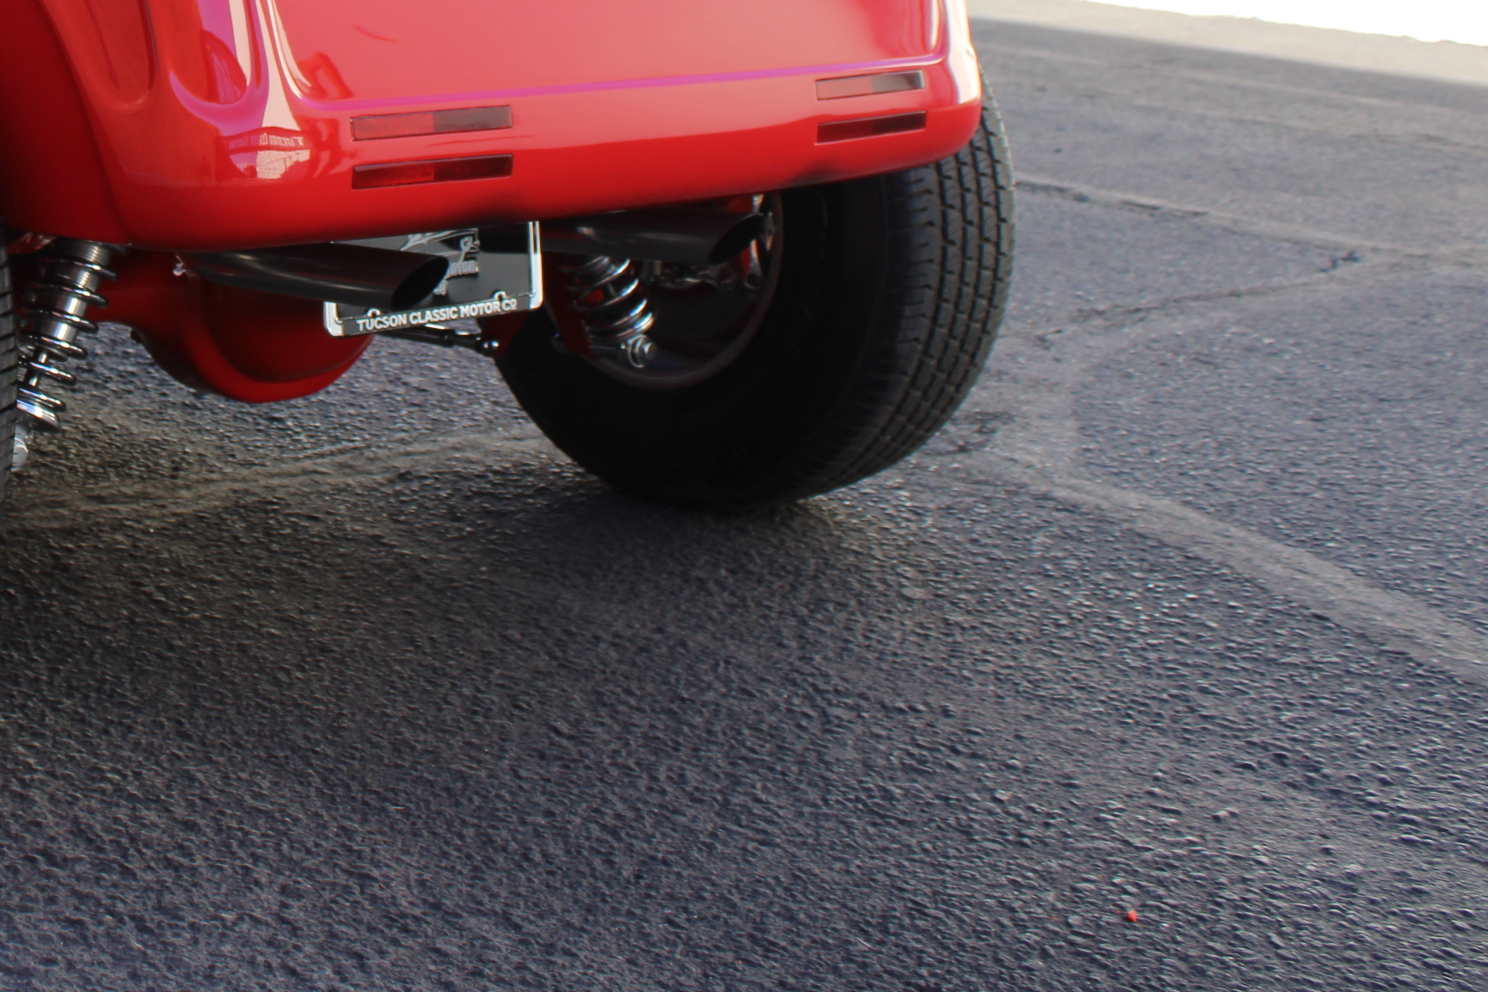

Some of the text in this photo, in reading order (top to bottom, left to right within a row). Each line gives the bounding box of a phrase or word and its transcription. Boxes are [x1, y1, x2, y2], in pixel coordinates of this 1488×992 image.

[356, 313, 408, 332] TUCSON
[408, 307, 459, 325] CLASSIC
[459, 300, 501, 318] MOTOR
